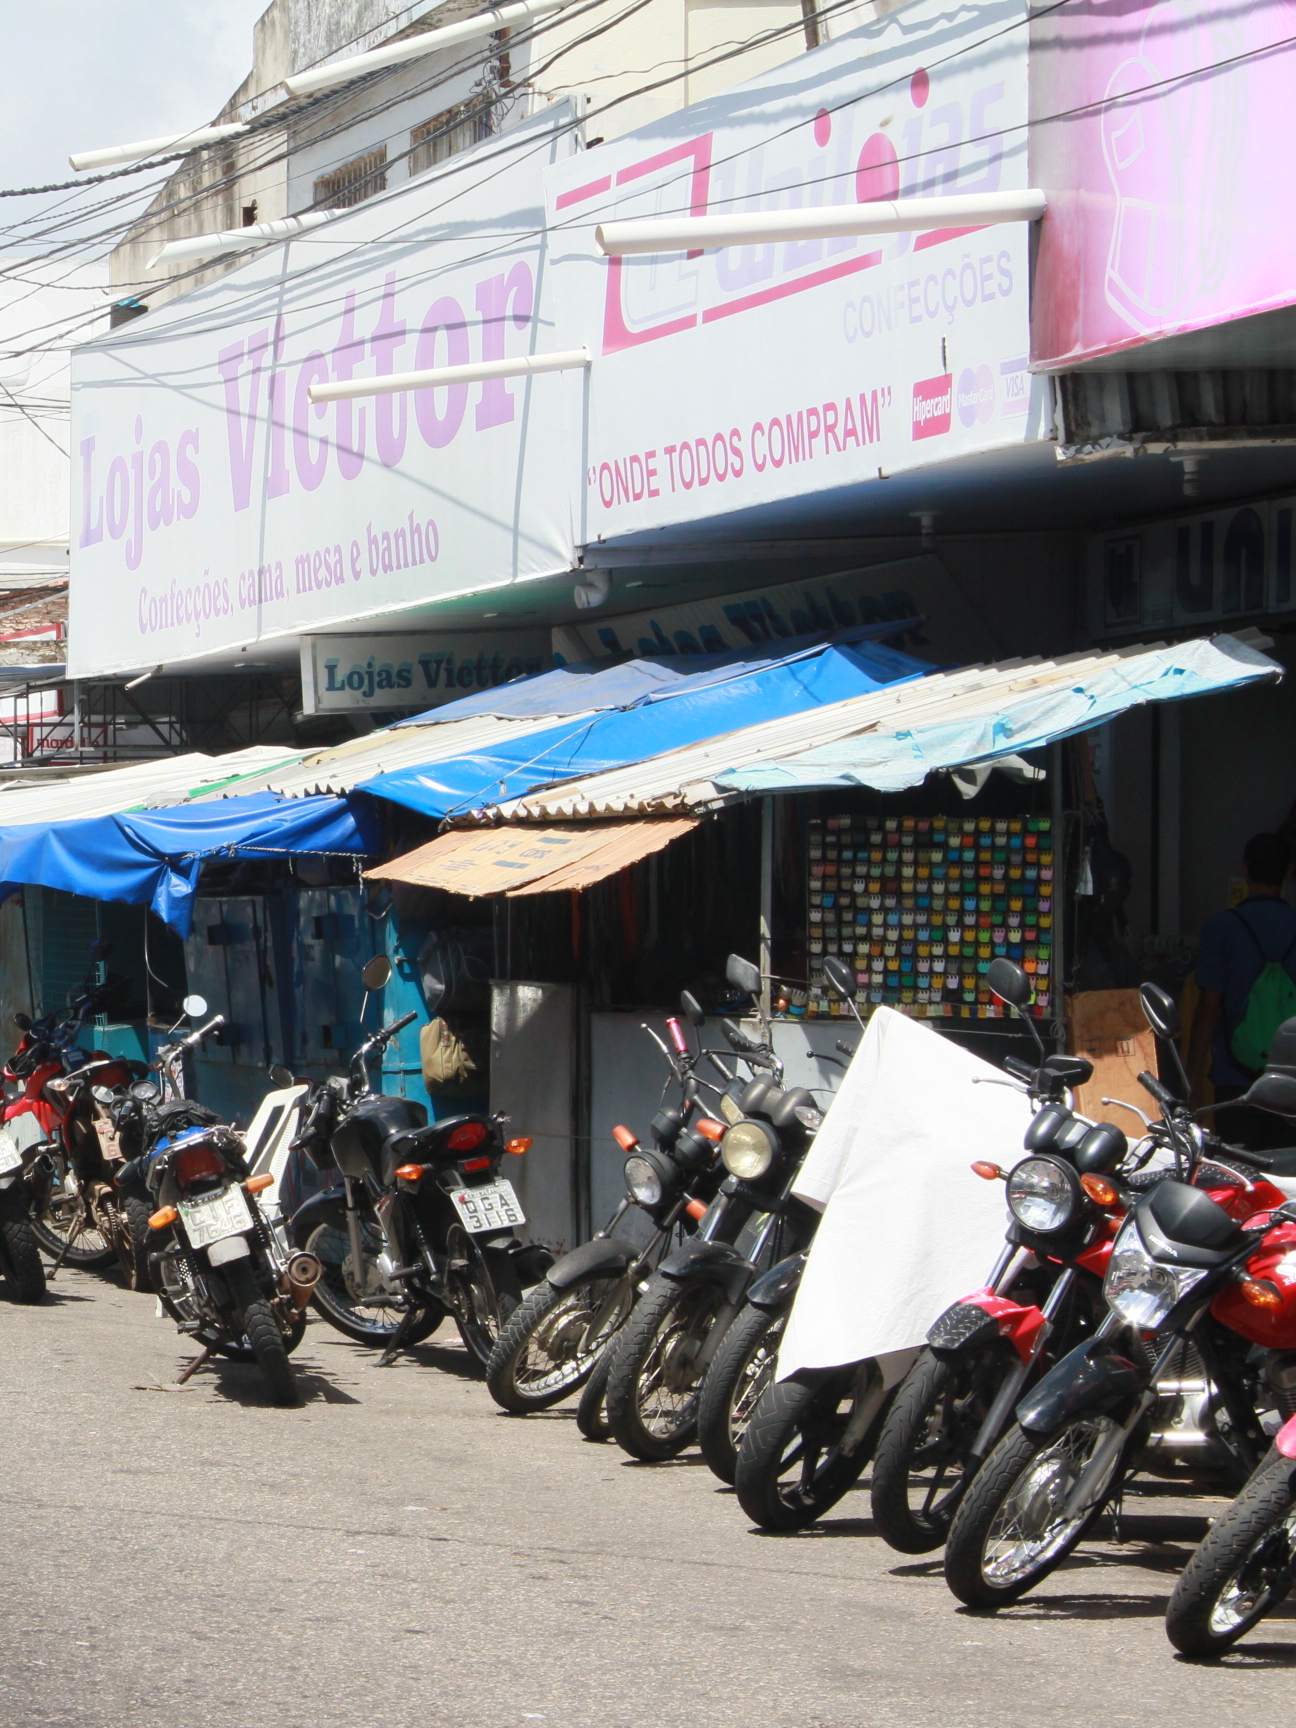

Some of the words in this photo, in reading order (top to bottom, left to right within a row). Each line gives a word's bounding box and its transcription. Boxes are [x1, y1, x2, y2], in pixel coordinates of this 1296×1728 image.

[843, 250, 1014, 344] CONFECÇÕES
[913, 387, 951, 426] Hipercard
[1006, 374, 1025, 398] VISA
[79, 413, 202, 571] Lojas
[217, 260, 535, 513] Victtor
[664, 427, 744, 496] TODOS
[295, 542, 345, 591] mesa
[349, 540, 362, 581] e
[367, 508, 440, 577] banho
[325, 654, 414, 698] Lojas
[464, 1193, 511, 1215] QGA
[468, 1207, 519, 1230] 3116
